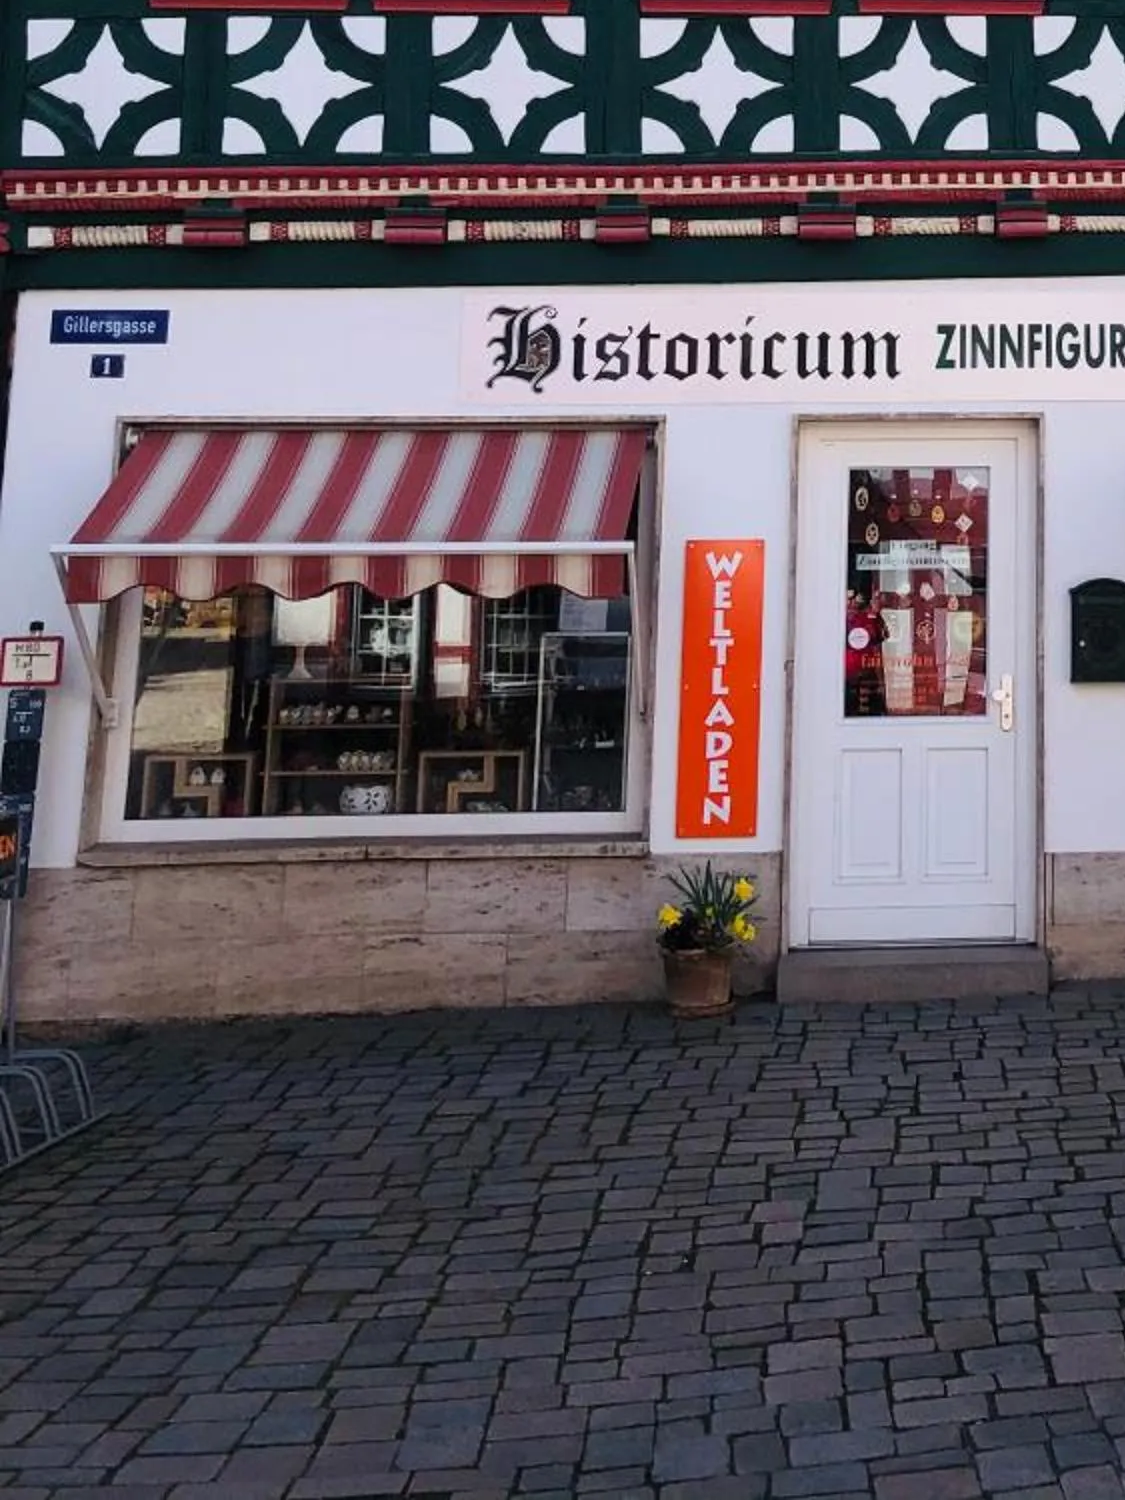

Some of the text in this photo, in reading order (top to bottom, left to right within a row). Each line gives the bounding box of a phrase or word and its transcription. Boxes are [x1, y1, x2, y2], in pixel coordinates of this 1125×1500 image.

[63, 315, 156, 338] Gillersgasse
[485, 304, 901, 393] Historicum
[102, 357, 111, 375] 1
[703, 551, 743, 825] WELTLADEN
